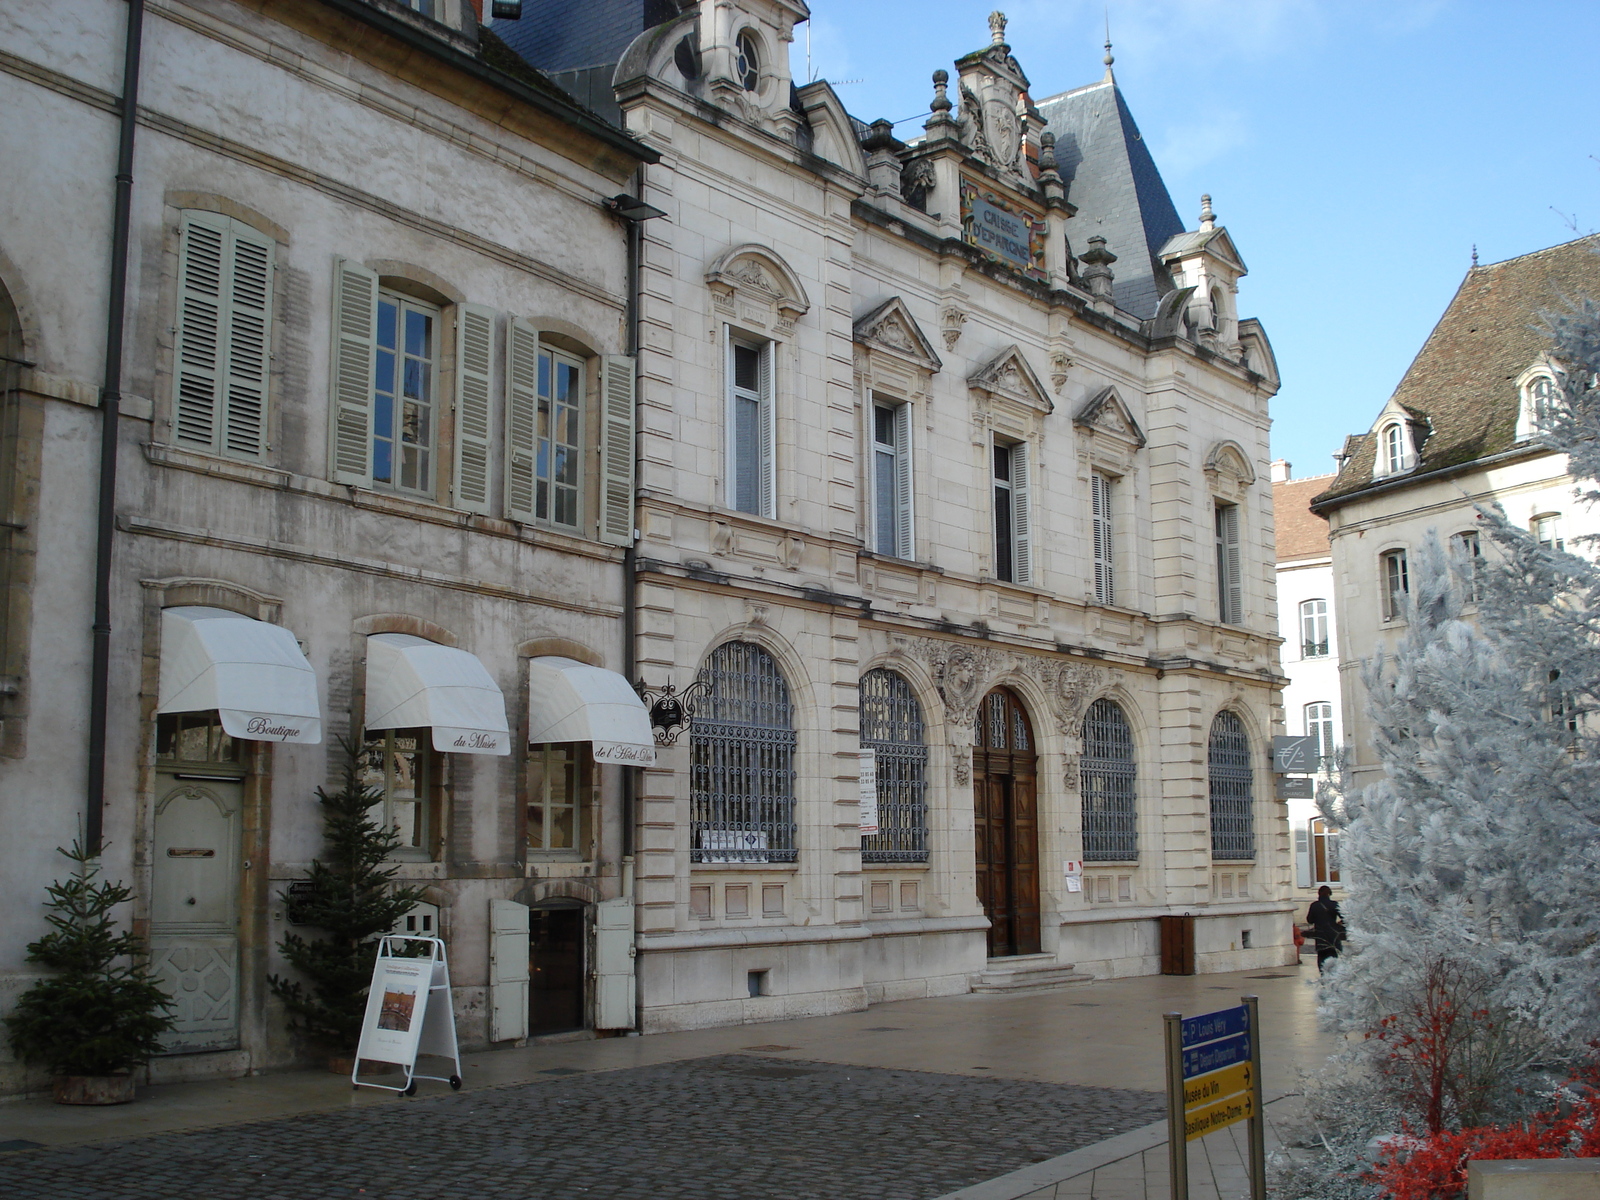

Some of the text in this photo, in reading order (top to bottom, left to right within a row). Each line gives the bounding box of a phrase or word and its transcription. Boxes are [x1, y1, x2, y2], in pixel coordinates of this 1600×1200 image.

[984, 209, 1019, 238] CAISSE
[246, 716, 300, 741] Boutique
[453, 732, 497, 749] du Musée
[595, 746, 606, 758] de
[1198, 1020, 1214, 1037] Louis
[1202, 1083, 1210, 1098] du
[1210, 1080, 1219, 1095] Vin
[1210, 1104, 1242, 1126] Notre-Dame
